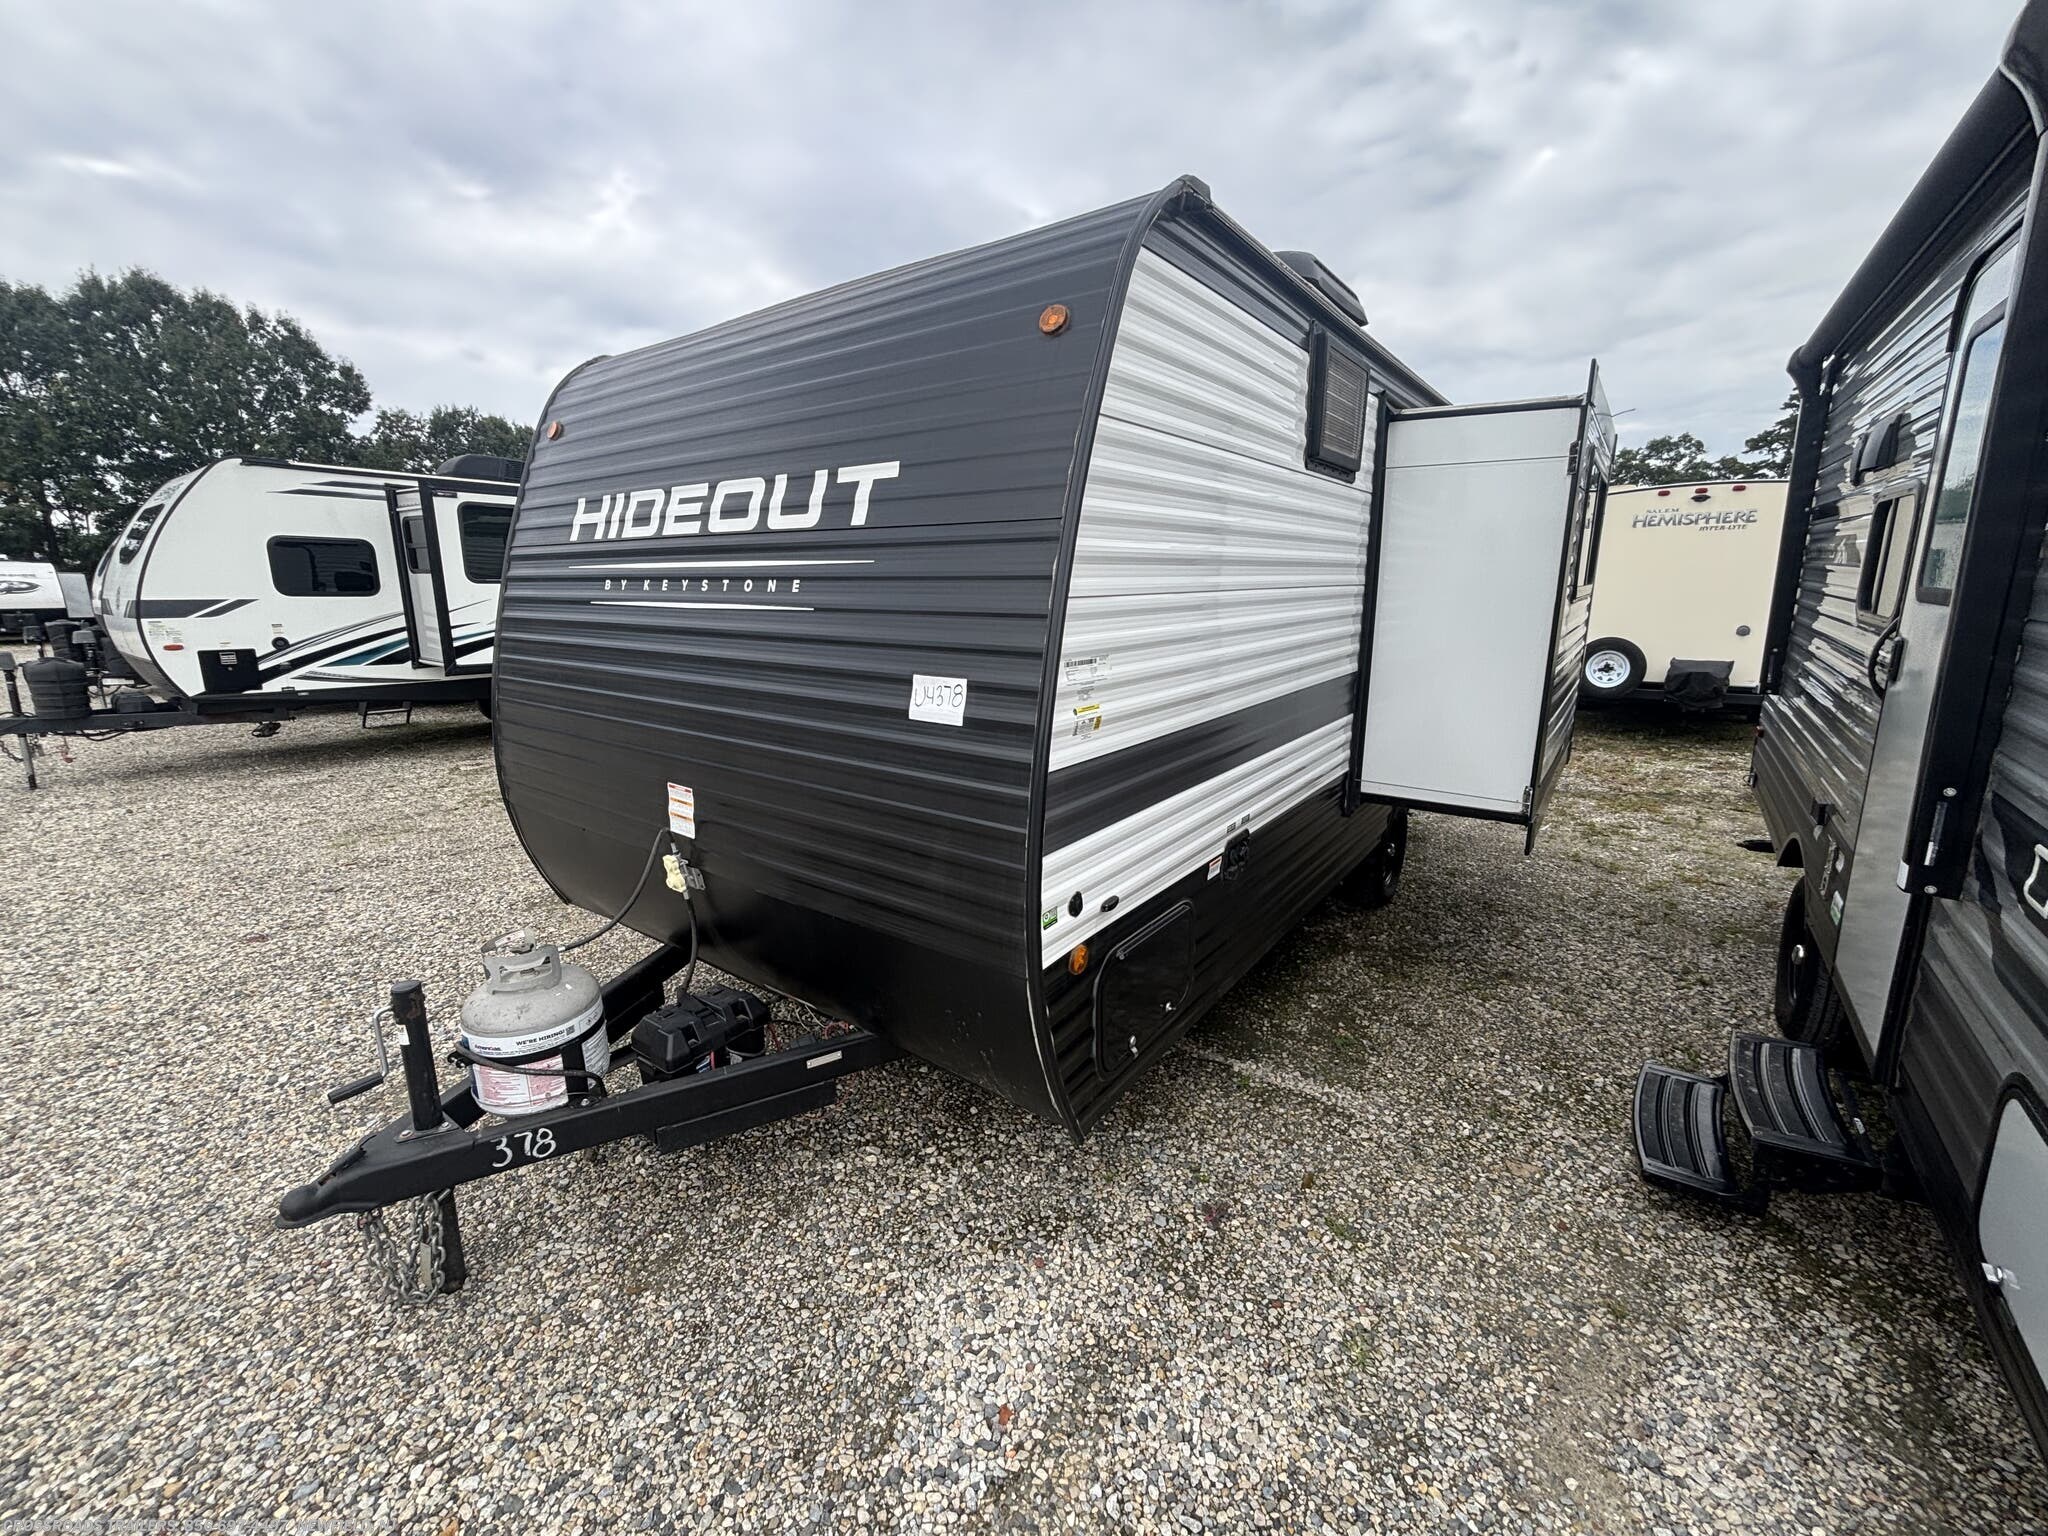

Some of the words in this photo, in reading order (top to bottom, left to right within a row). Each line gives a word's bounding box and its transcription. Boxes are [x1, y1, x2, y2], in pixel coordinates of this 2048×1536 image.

[569, 460, 900, 541] HIDEOUT
[1632, 510, 1758, 528] HEMISPHERE
[604, 579, 628, 591] BY
[643, 579, 801, 593] KEYSTONE
[914, 683, 964, 708] U4378
[516, 1038, 537, 1046] WE'RE
[538, 1029, 565, 1041] HIRING!
[490, 1127, 557, 1168] 378
